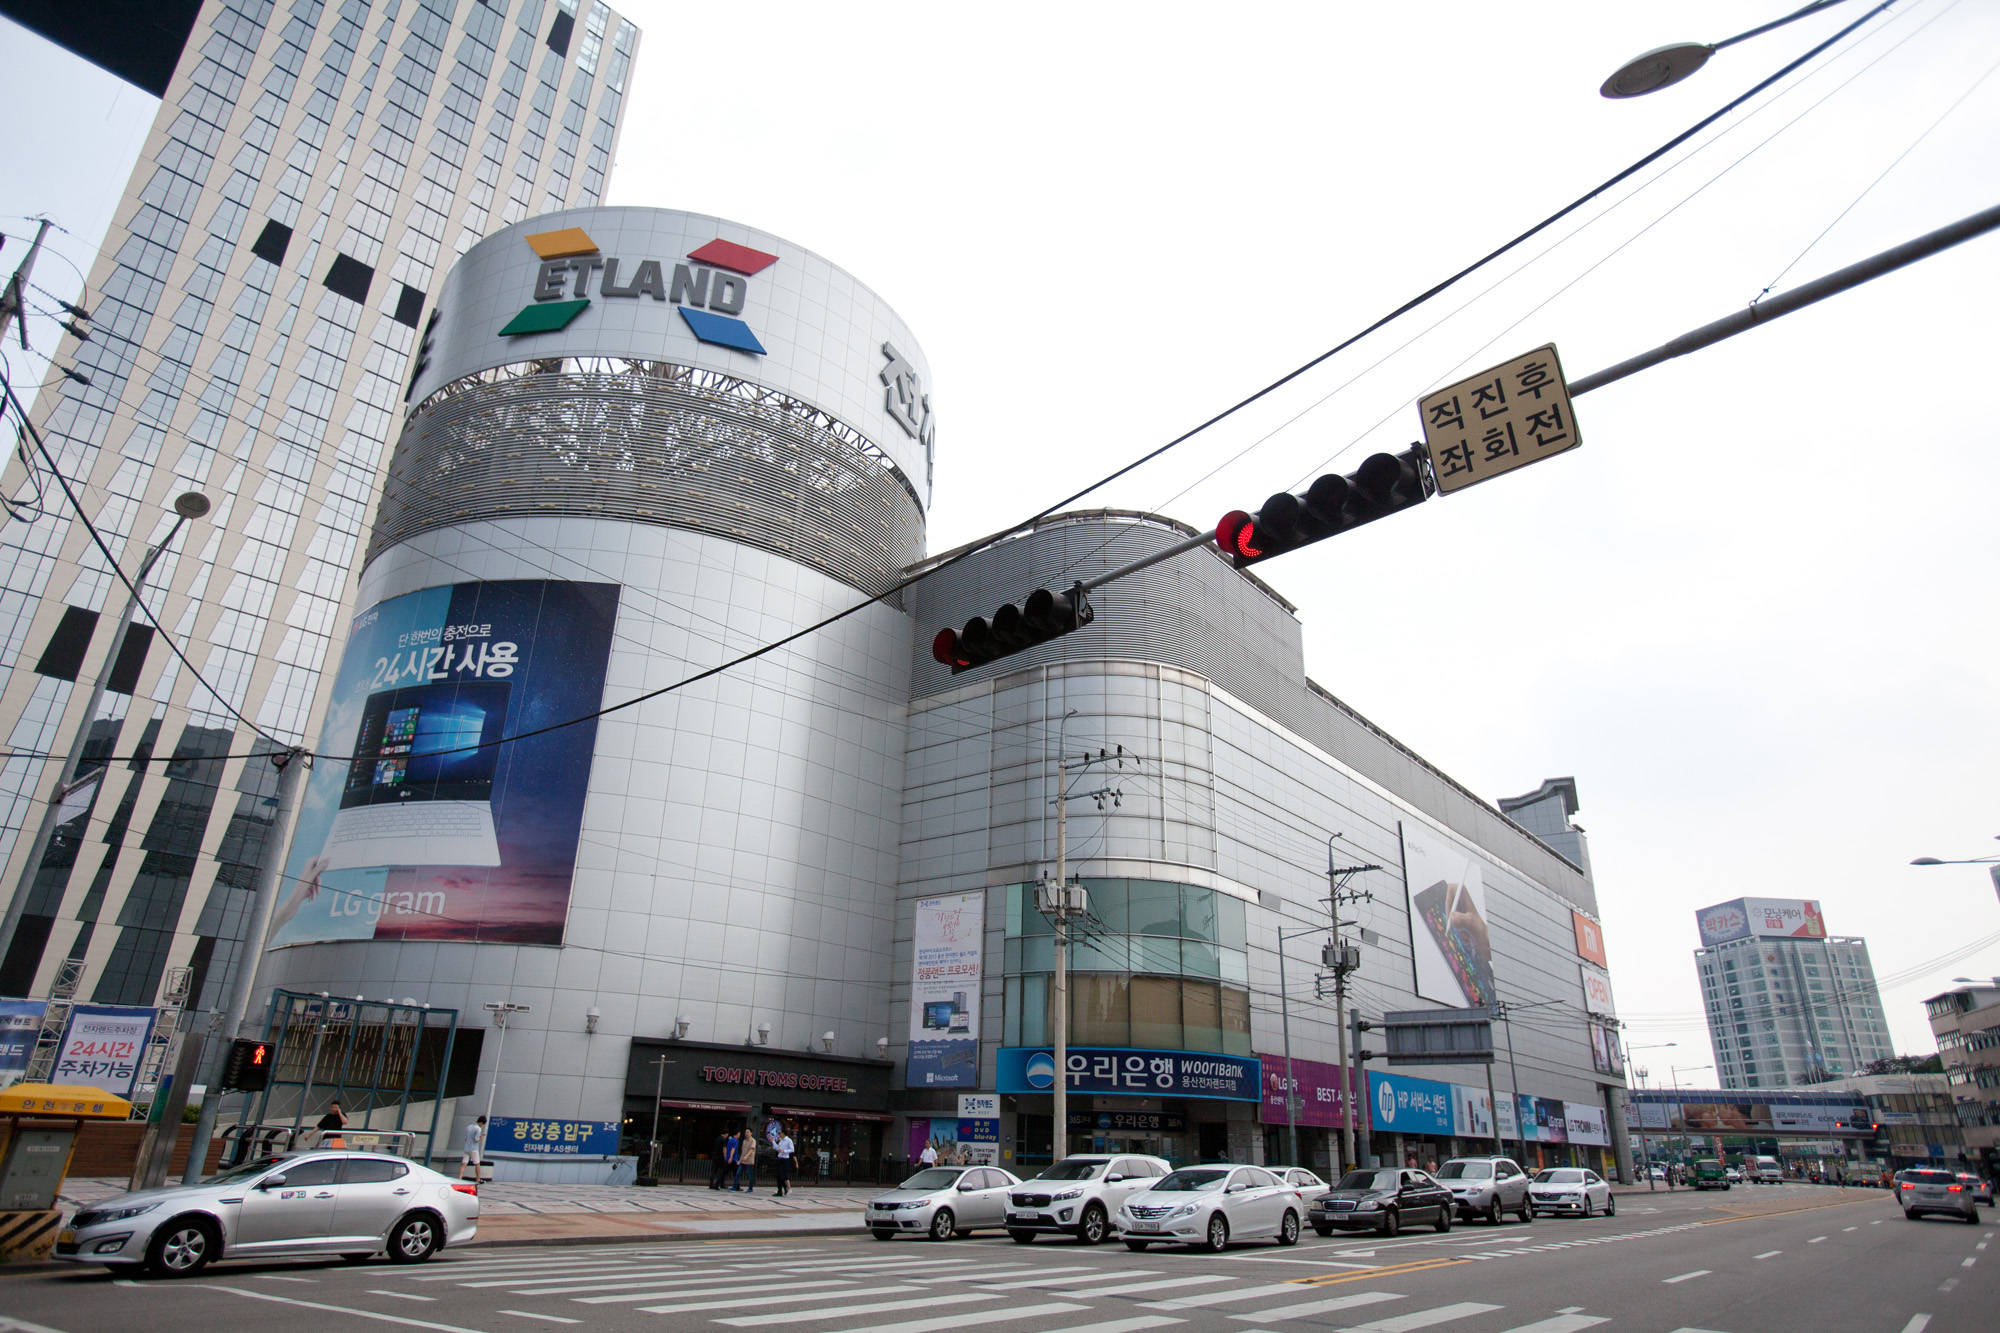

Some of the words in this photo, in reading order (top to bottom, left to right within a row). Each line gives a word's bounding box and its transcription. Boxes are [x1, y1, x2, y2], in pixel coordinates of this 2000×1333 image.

[533, 257, 747, 315] ETLAND
[1429, 362, 1555, 430] 직진후
[1440, 403, 1567, 478] 좌회전
[398, 632, 409, 648] 단
[411, 627, 443, 646] 한번의
[443, 624, 492, 641] 충전으로
[369, 644, 455, 690] 24시간
[456, 641, 519, 678] 사용
[329, 889, 365, 918] LG
[366, 891, 446, 925] gram
[1764, 908, 1801, 920] 모닝케어
[1705, 912, 1740, 931] 박카스
[947, 963, 979, 976] 프로모션!
[1588, 976, 1609, 1005] OPEN
[82, 1025, 138, 1035] 전자랜드주차장
[69, 1040, 134, 1058] 24시간
[57, 1060, 134, 1079] 주차가능
[703, 1066, 740, 1083] TOM
[743, 1069, 756, 1085] N
[758, 1070, 797, 1088] TOMS
[799, 1074, 847, 1092] COFFEE
[934, 1073, 959, 1081] Microsoft
[1066, 1055, 1174, 1088] 우리은행
[1278, 1077, 1298, 1092] LG자
[1317, 1087, 1336, 1102] BEST
[22, 1099, 55, 1111] 안전
[1397, 1090, 1409, 1109] HP
[1410, 1091, 1432, 1113] 서비스
[1432, 1094, 1447, 1115] 센터
[1114, 1114, 1159, 1128] 우리은행
[513, 1121, 561, 1140] 광장층
[564, 1123, 593, 1142] 입구
